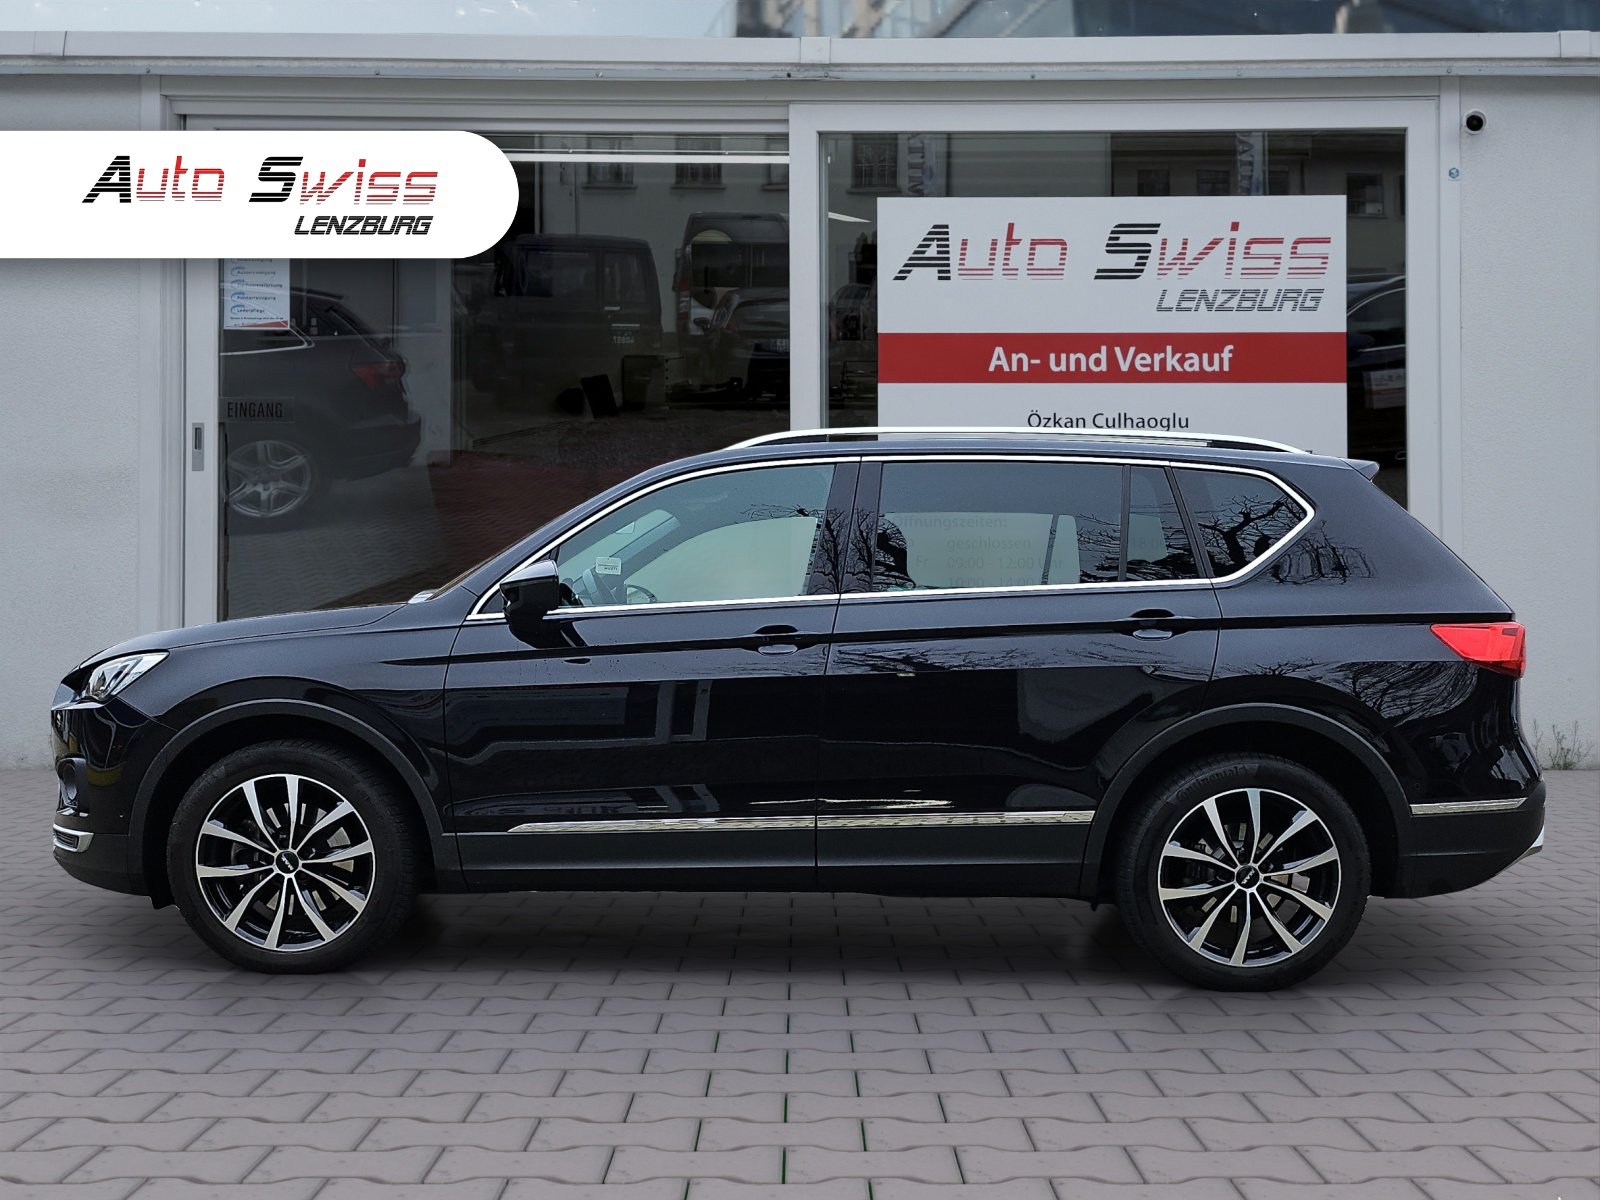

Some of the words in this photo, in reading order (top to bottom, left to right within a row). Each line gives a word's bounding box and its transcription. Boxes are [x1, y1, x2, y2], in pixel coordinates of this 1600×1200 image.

[893, 222, 1068, 280] Auto
[1094, 221, 1332, 280] Swiss
[1156, 288, 1325, 312] LENZBURG
[988, 345, 1040, 372] An-
[1049, 345, 1107, 372] und
[1115, 344, 1234, 372] Verkauf
[227, 401, 283, 418] EINGANG
[1027, 409, 1086, 428] Özkan
[1092, 411, 1189, 431] Culhaoglu
[946, 536, 1031, 552] geschlossen
